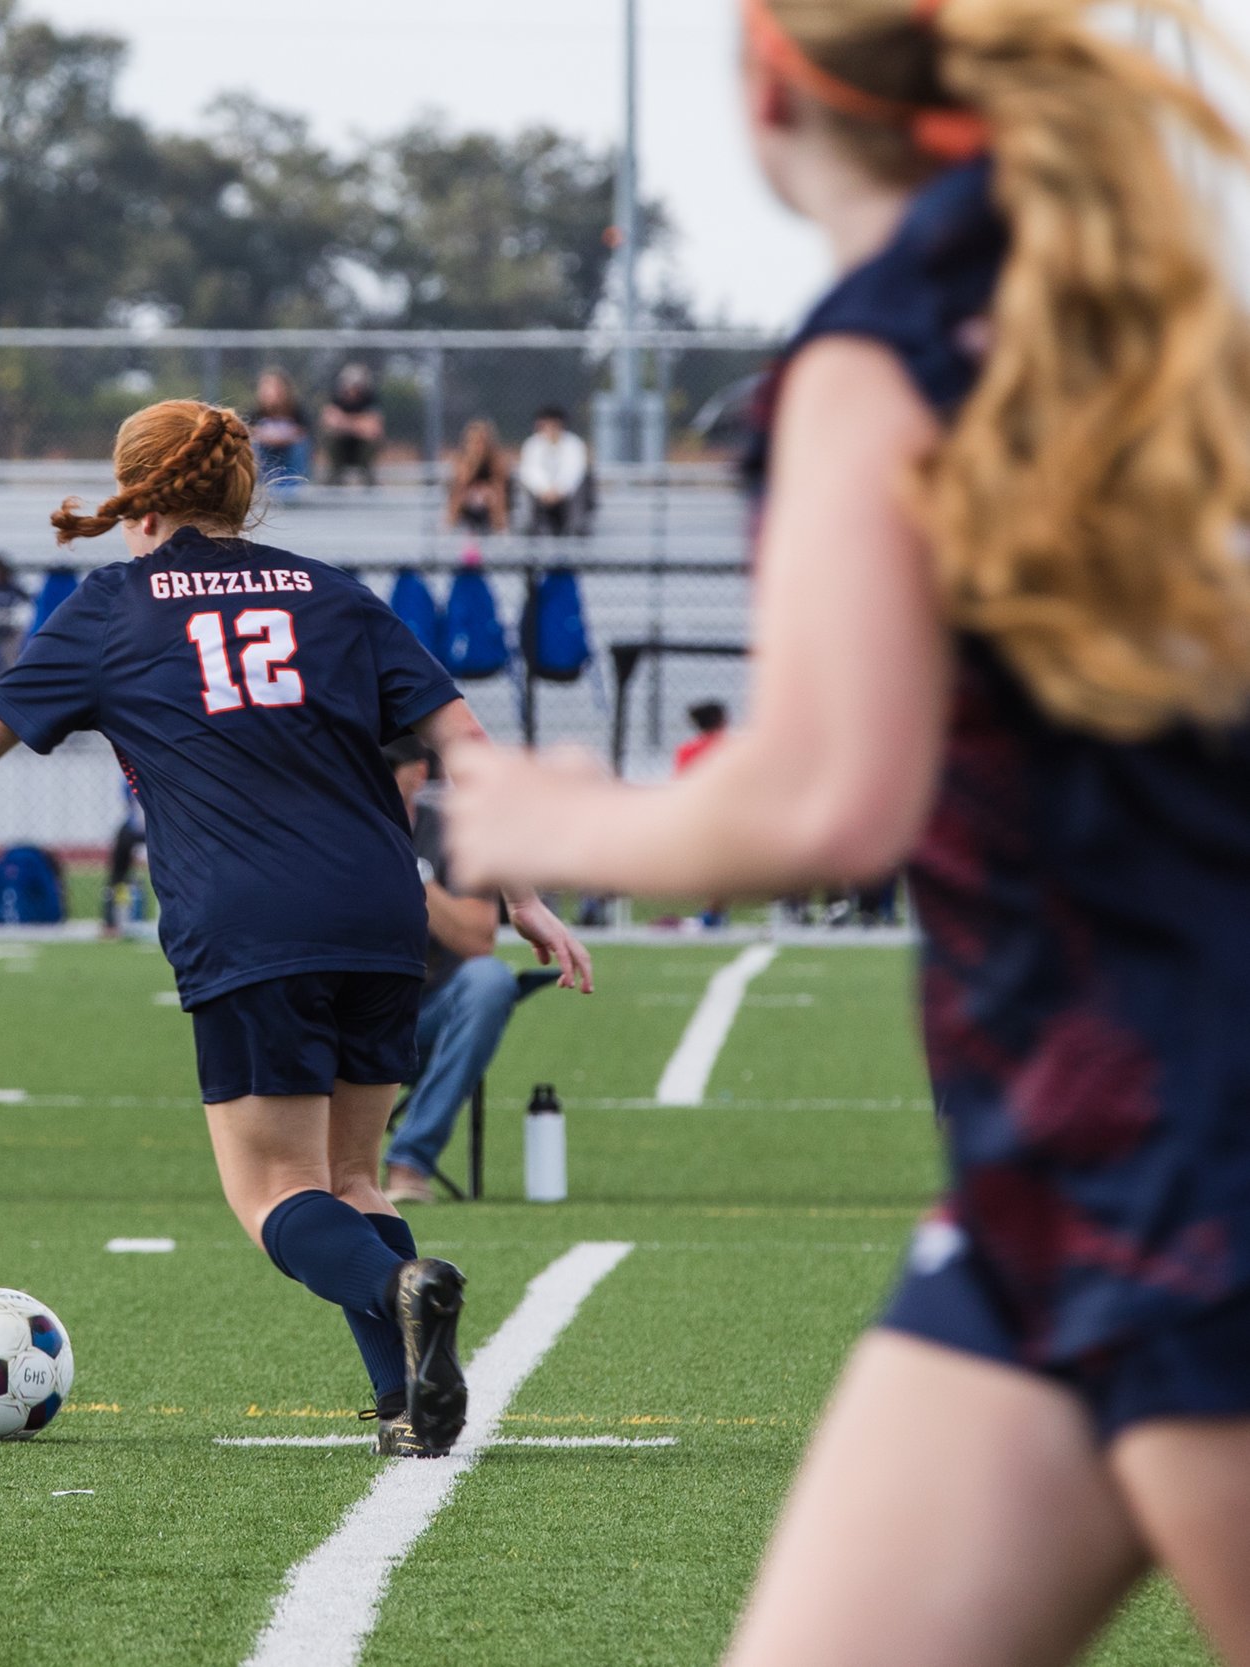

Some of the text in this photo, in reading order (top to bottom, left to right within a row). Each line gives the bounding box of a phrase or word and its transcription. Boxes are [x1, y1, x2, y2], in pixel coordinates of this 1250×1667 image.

[150, 570, 313, 599] GRIZZLIES
[186, 608, 305, 715] 12
[24, 1367, 47, 1385] GHS
